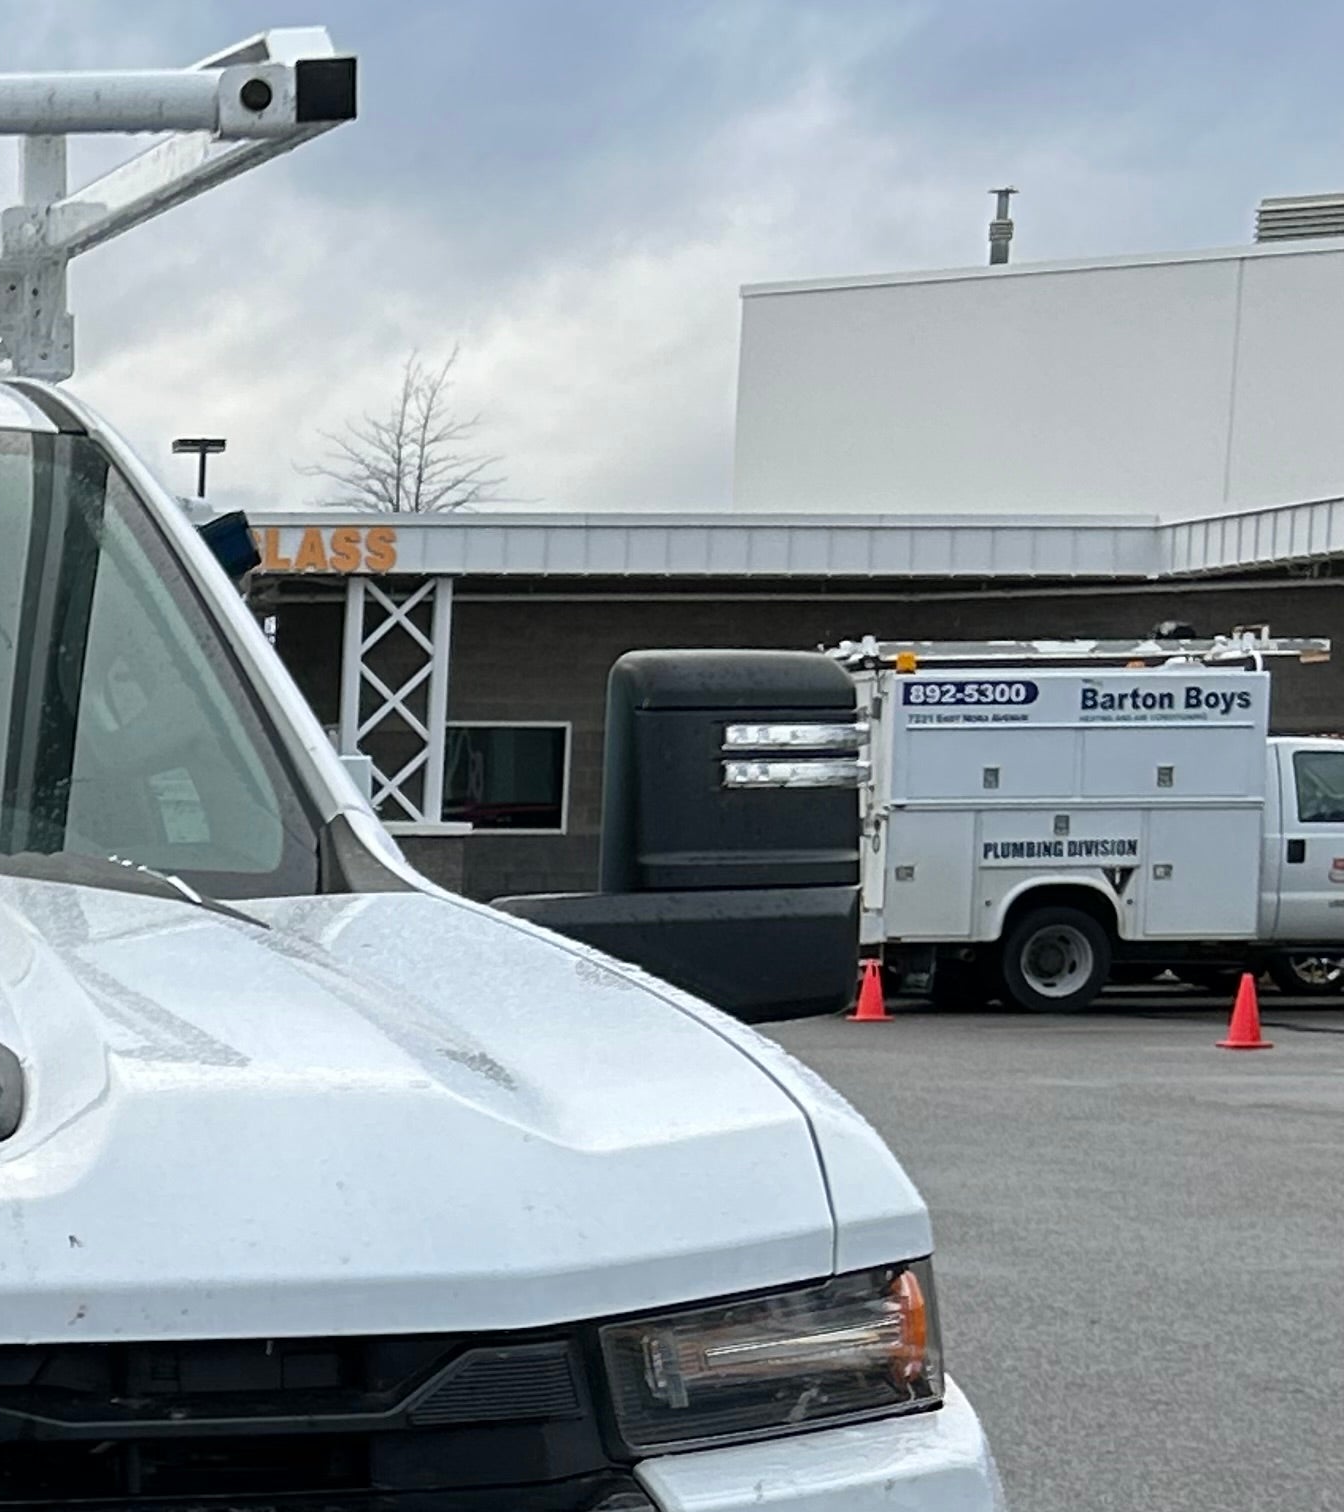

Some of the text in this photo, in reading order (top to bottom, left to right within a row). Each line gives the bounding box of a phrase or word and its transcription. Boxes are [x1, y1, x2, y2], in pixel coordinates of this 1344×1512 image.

[253, 526, 397, 573] LASS
[910, 683, 1026, 704] 892-5300
[1081, 686, 1252, 716] Barton Boys
[983, 839, 1138, 860] PLUMBING DIVISION
